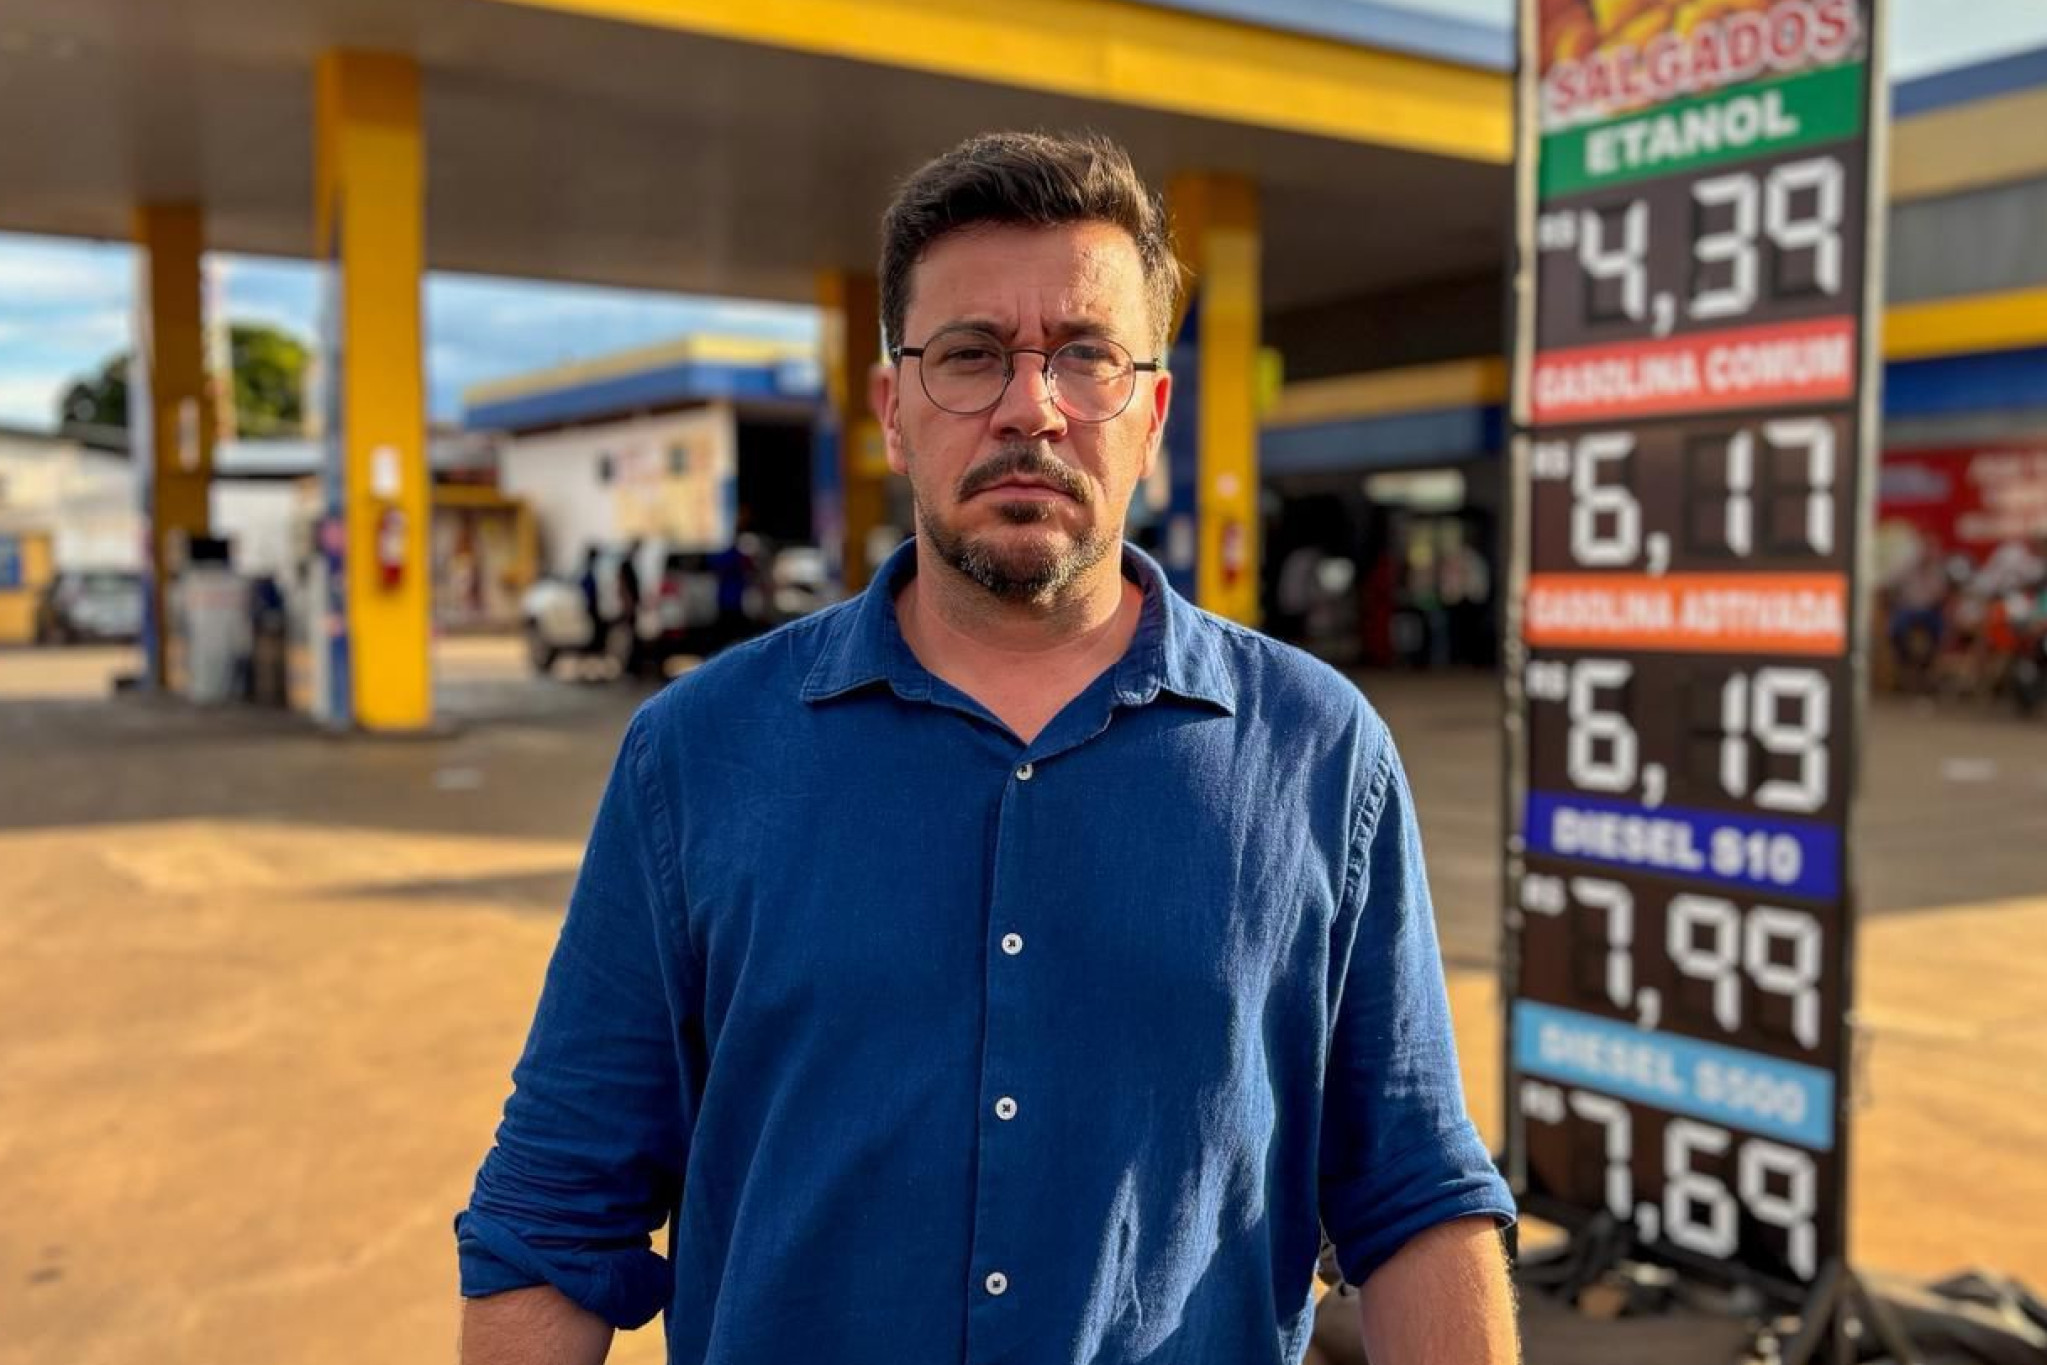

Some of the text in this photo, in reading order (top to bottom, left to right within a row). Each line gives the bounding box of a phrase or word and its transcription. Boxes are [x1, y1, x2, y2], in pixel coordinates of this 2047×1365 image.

[1547, 0, 1854, 115] SALGADOS
[1585, 90, 1800, 175] ETANOL
[1579, 156, 1844, 338] 4,39
[1536, 333, 1849, 410] GASOLINA COMUM
[1571, 416, 1835, 578] 6,17
[1530, 588, 1672, 633] GASOLINA
[1568, 658, 1831, 813] 6,19
[1551, 806, 1803, 885] DIESEL S10
[1570, 875, 1822, 1049] 7,99
[1539, 1023, 1808, 1126] DIESEL S500
[1569, 1089, 1818, 1281] 7,69
